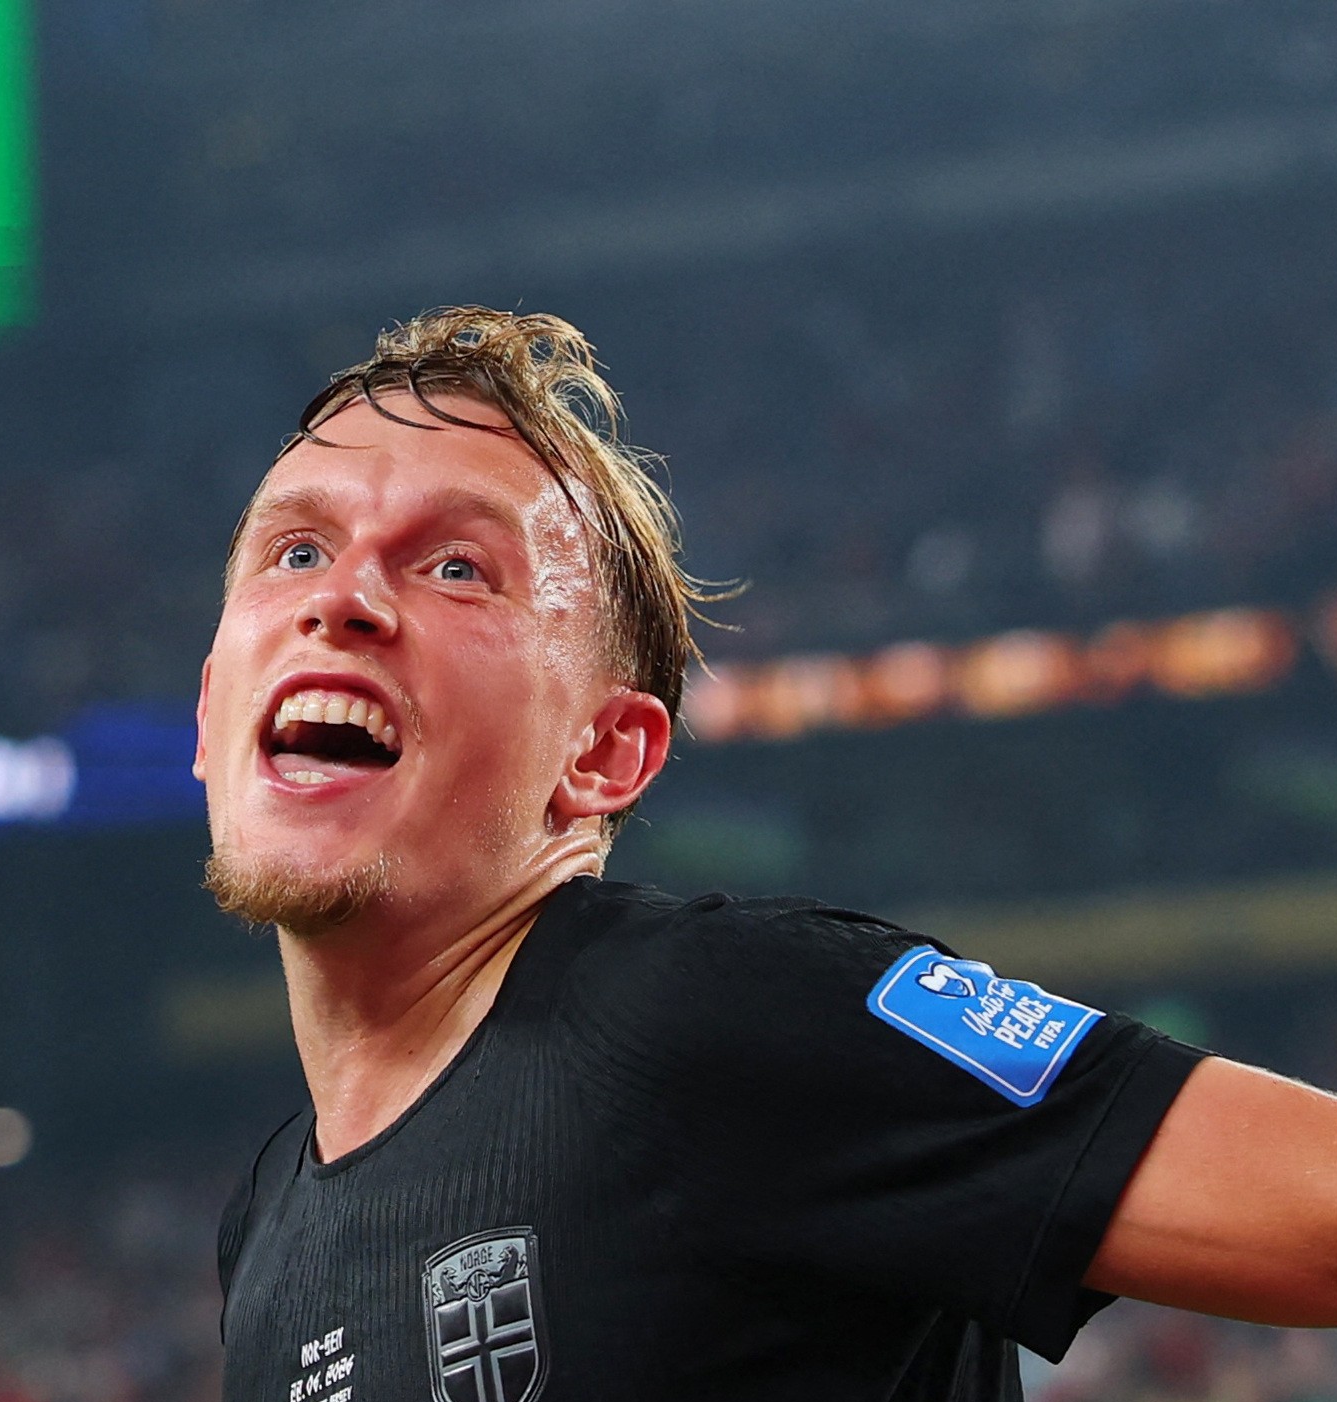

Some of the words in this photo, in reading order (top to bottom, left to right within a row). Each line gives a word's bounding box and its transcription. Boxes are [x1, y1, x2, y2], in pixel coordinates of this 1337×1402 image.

[962, 995, 1004, 1036] Unite
[993, 996, 1053, 1049] PEACE
[1033, 1020, 1066, 1050] FIFA
[460, 1246, 493, 1271] NORGE
